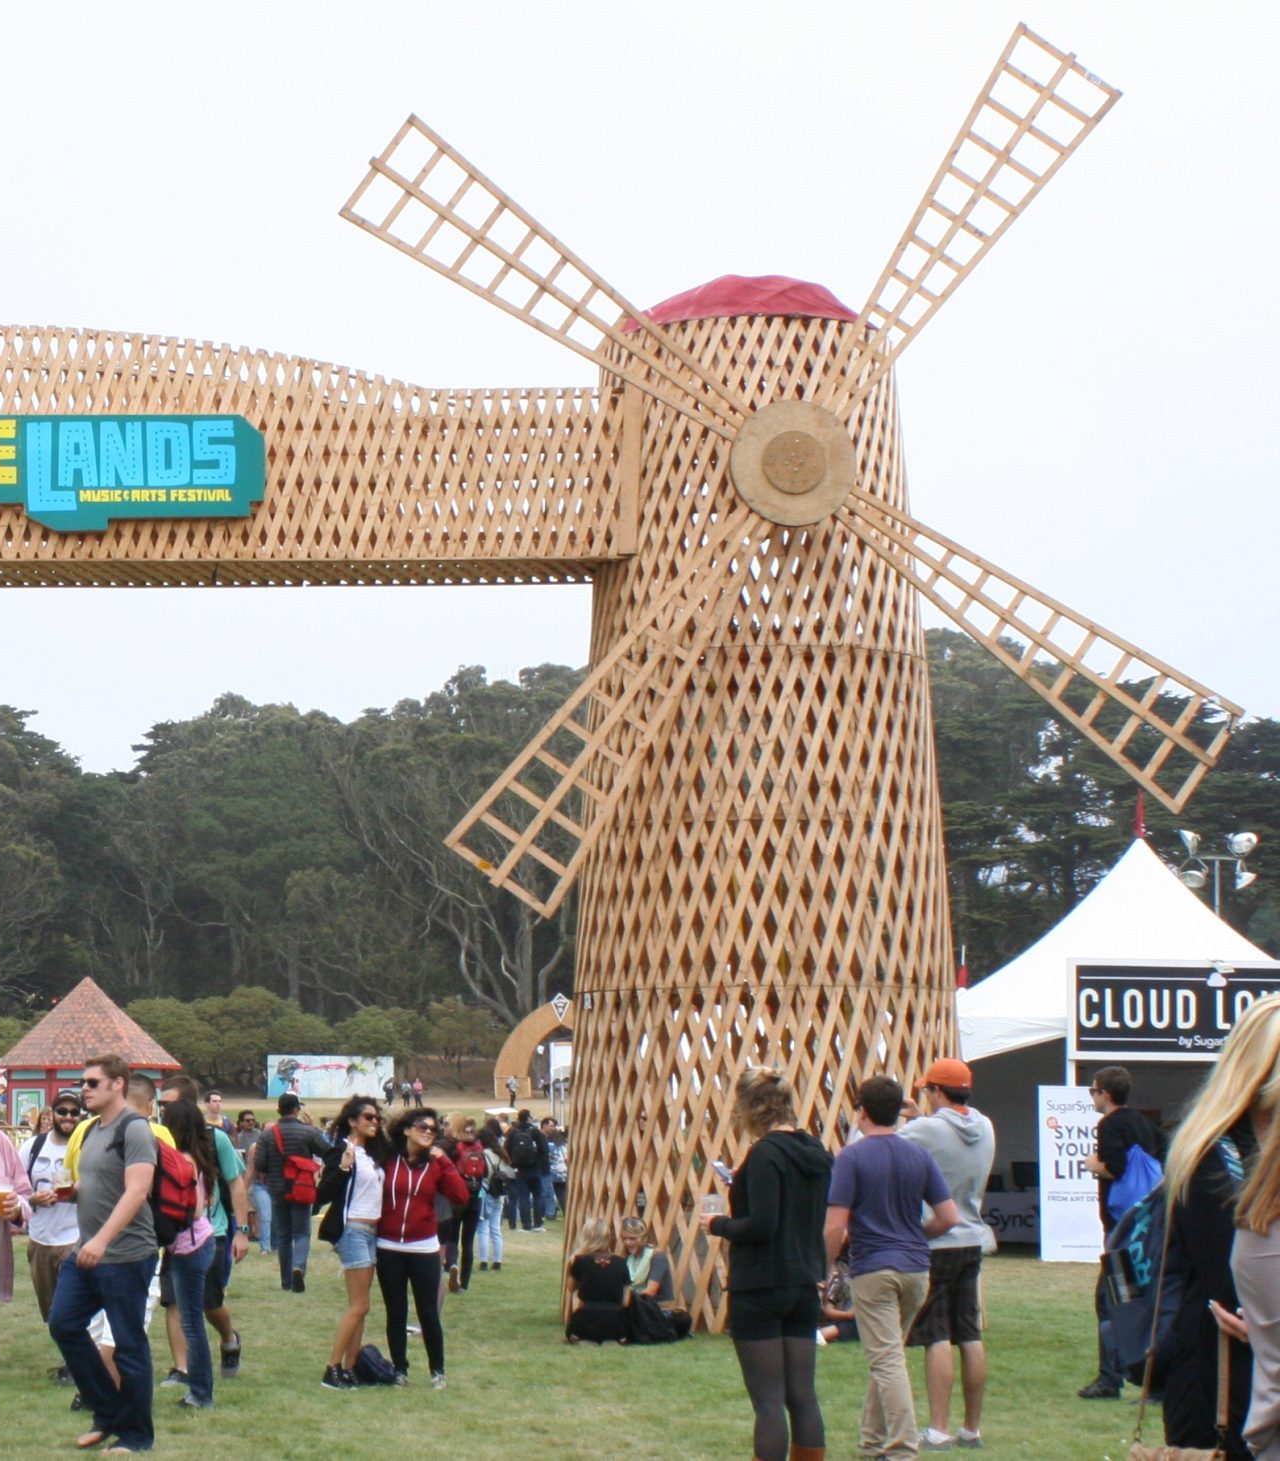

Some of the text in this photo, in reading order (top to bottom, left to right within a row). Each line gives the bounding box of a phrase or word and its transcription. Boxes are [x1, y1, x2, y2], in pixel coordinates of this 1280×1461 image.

[25, 419, 236, 512] LANDS
[79, 489, 122, 502] MUSIC
[131, 489, 166, 502] ARTS
[170, 489, 232, 502] FESTIVAL
[1079, 987, 1197, 1030] CLOUD
[1178, 1035, 1192, 1048] by
